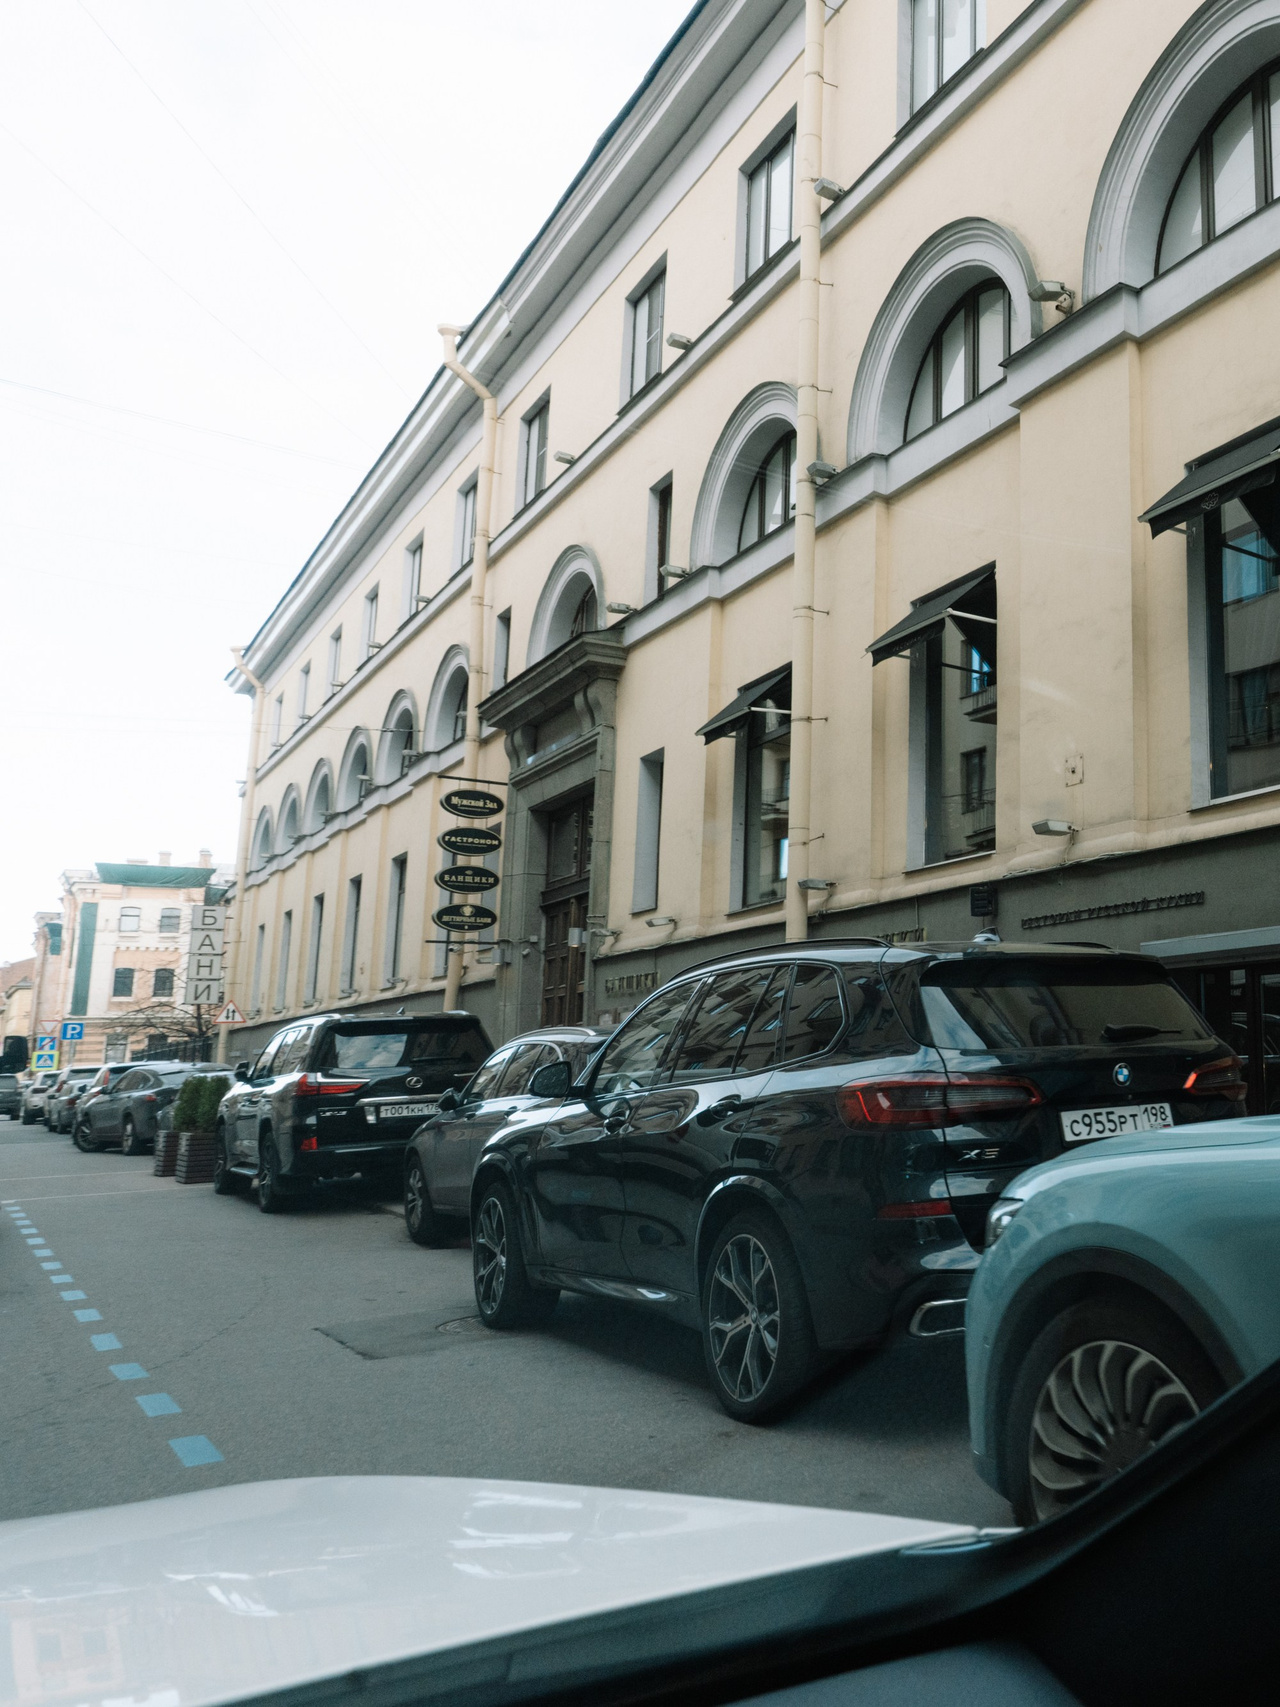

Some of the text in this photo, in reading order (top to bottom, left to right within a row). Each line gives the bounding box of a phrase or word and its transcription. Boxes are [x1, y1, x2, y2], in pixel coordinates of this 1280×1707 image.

[444, 835, 499, 846] ГАСТРОНОМ
[444, 874, 495, 884] БАНЩИКИ
[193, 908, 218, 1001] БАНИ
